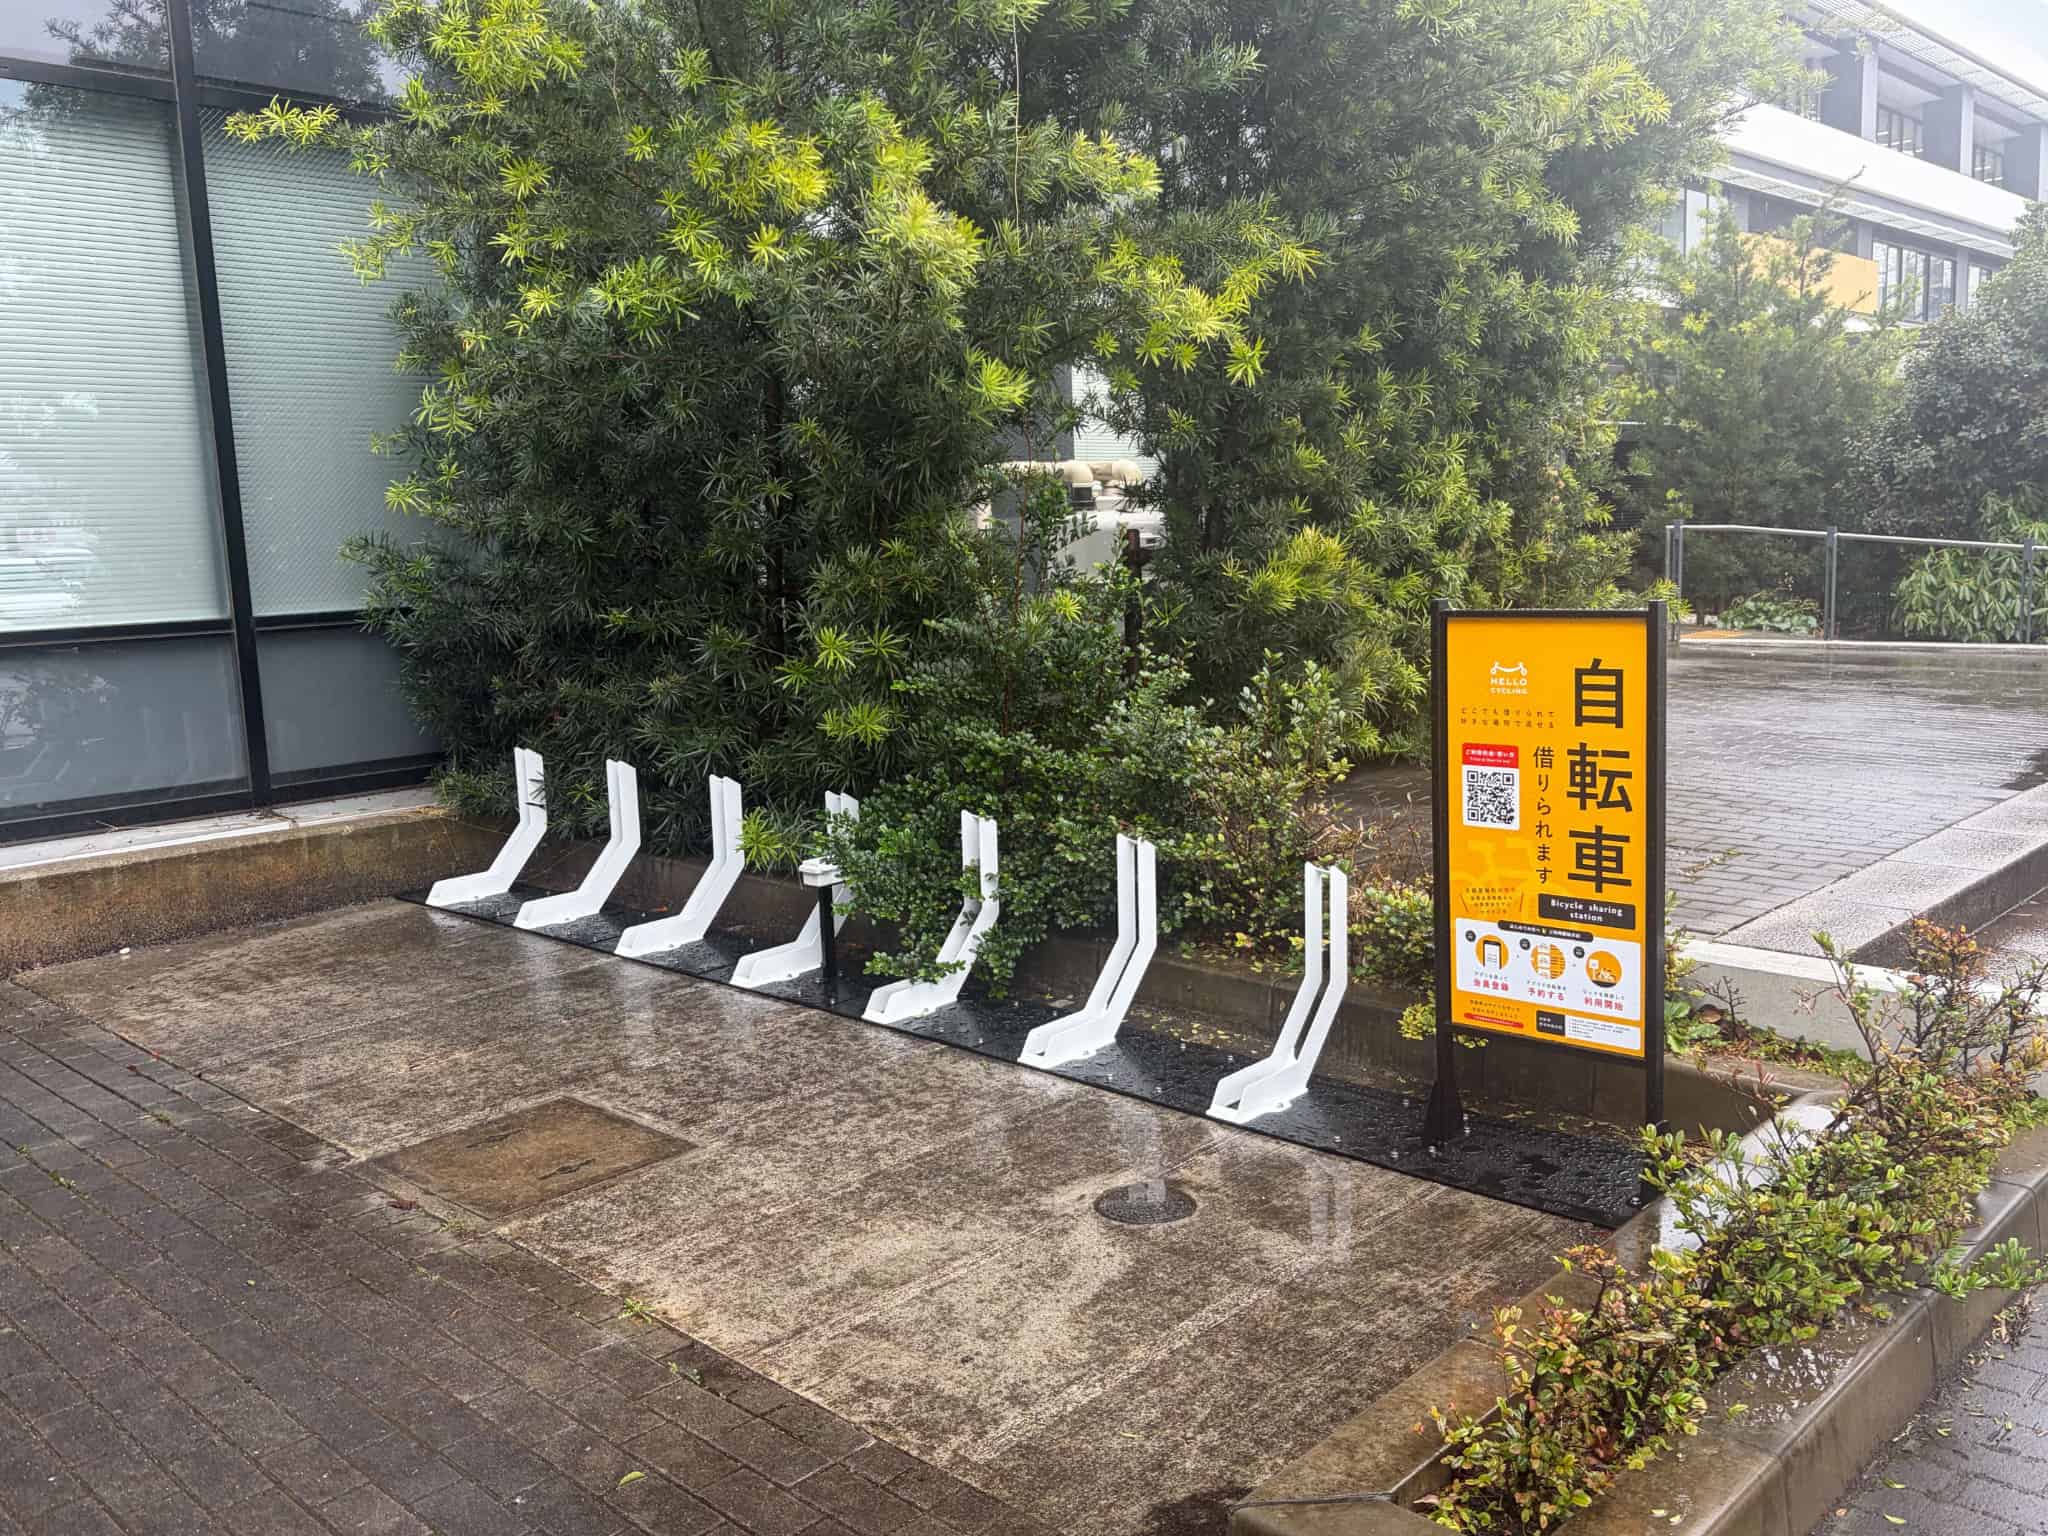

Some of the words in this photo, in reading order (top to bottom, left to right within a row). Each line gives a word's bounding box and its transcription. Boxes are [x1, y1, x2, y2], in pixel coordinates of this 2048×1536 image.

[1490, 677, 1527, 686] HELLO
[1566, 658, 1632, 893] 自転車
[1533, 746, 1554, 884] 借りられます
[1551, 899, 1583, 910] Bicycle
[1589, 903, 1623, 917] sharing
[1570, 912, 1603, 922] station
[1527, 987, 1565, 1001] 予約する
[1584, 996, 1624, 1011] 利用開始
